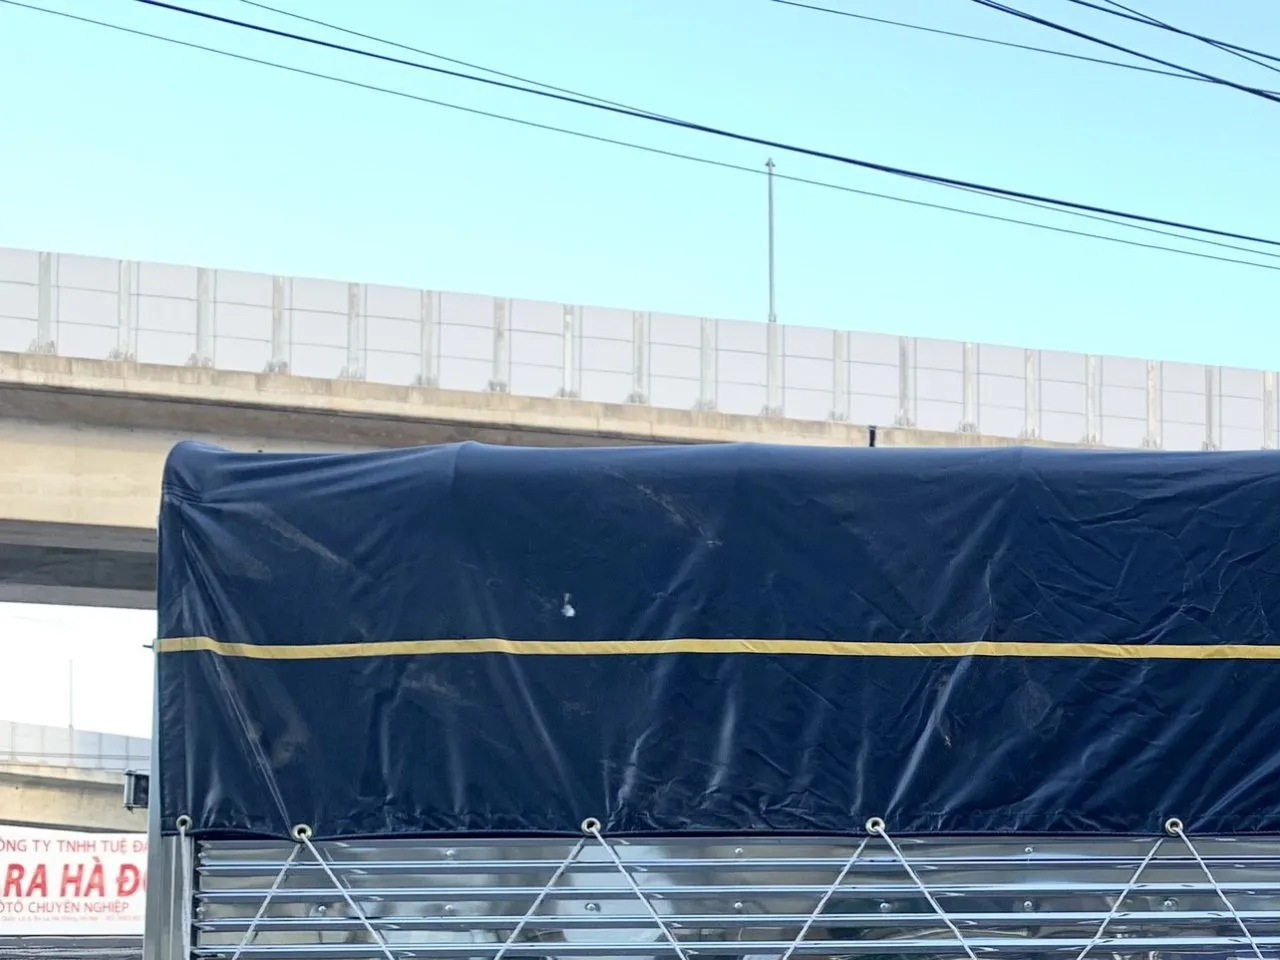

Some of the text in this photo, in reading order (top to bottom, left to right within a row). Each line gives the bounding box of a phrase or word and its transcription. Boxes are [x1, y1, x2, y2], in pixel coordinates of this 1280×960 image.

[32, 839, 51, 853] TY
[57, 839, 96, 853] TNHH
[60, 856, 105, 898] HÀ
[116, 863, 147, 898] Đ
[28, 899, 80, 914] CHUYÊN
